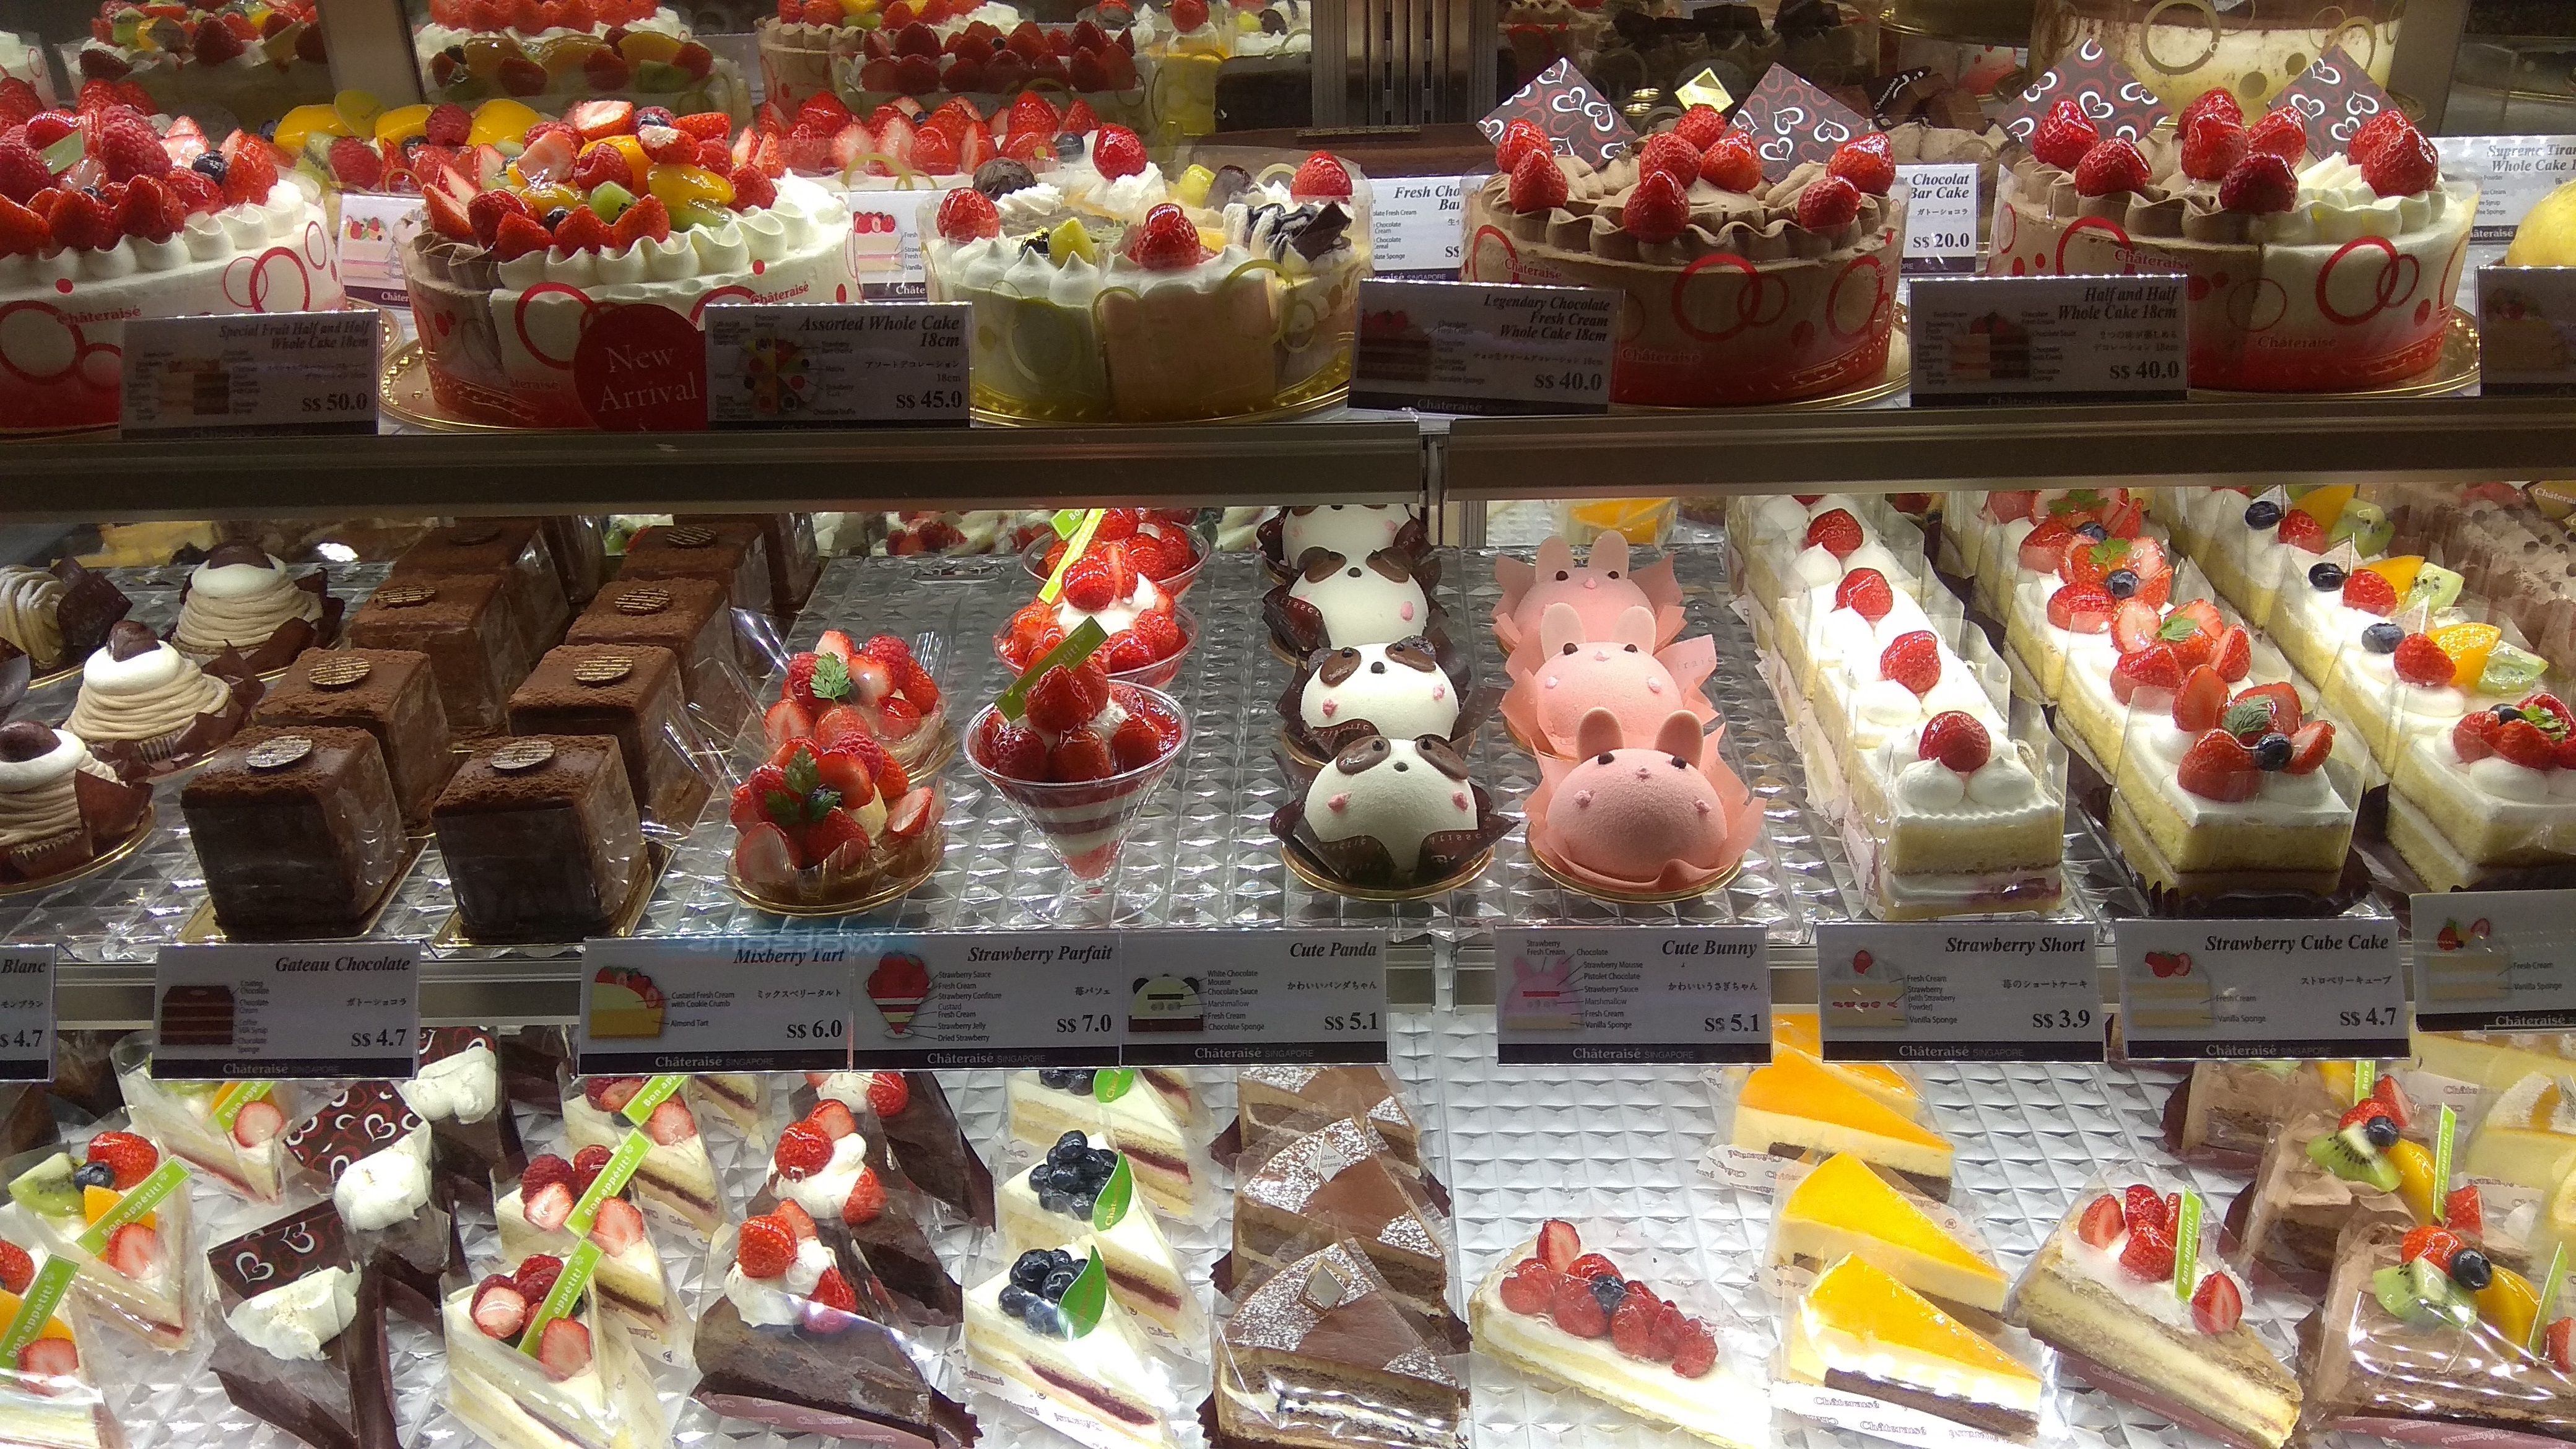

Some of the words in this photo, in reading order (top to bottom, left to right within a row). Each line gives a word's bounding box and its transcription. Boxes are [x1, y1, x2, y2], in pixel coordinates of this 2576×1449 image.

[2492, 160, 2531, 172] Whole
[2536, 159, 2567, 171] Cake
[1913, 173, 1969, 185] Chocolat
[1393, 186, 1430, 198] Fresh
[1936, 187, 1969, 198] Cake
[1913, 237, 1930, 248] S$
[1933, 233, 1969, 248] 20.0
[1484, 294, 1547, 310] Legendary
[1550, 297, 1610, 311] Chocolate
[2085, 288, 2115, 303] Half
[2117, 289, 2143, 302] and
[2146, 287, 2177, 302] Half
[1530, 310, 1565, 326] Fresh
[1568, 314, 1608, 327] Cream
[2058, 305, 2101, 321] Whole
[2104, 307, 2139, 320] Cake
[2143, 305, 2177, 320] 18cm
[219, 323, 257, 340] Special
[263, 322, 289, 337] Fruit
[320, 321, 340, 334] and
[343, 320, 370, 336] Half
[798, 315, 863, 332] Assorted
[869, 314, 916, 331] Whole
[921, 315, 959, 331] Cake
[920, 333, 960, 347] 18cm
[1500, 324, 1538, 338] Whole
[1541, 327, 1572, 340] Cake
[1575, 330, 1607, 342] 18cm
[272, 335, 306, 350] Whole
[309, 336, 336, 348] Cake
[604, 344, 675, 373] New
[2135, 361, 2179, 379] 40.0
[936, 374, 960, 383] 18cm
[1559, 372, 1603, 391] 40.0
[598, 372, 698, 412] Arrival
[921, 391, 962, 409] 45.0
[326, 393, 367, 411] 50.0
[1290, 942, 1325, 958] Cute
[1329, 942, 1377, 957] Panda
[1662, 940, 1700, 955] Cute
[1704, 940, 1758, 958] Bunny
[1946, 937, 2036, 955] Strawberry
[2039, 937, 2086, 952] Short
[2205, 934, 2296, 954] Strawberry
[2300, 934, 2343, 950] Cube
[2348, 934, 2389, 949] Cake
[733, 948, 806, 966] Mixberry
[812, 948, 844, 962] Tart
[968, 946, 1054, 965] Strawberry
[1056, 945, 1112, 961] Parfait
[1, 959, 46, 973] Blanc
[276, 957, 331, 972] Gateau
[335, 957, 411, 971] Chocolate
[1907, 985, 1943, 994] Strawberry
[2537, 983, 2562, 991] Sponge
[938, 992, 972, 1001] Strawberry
[1924, 994, 1956, 1003] Strawberry
[1056, 1018, 1076, 1033] S$
[1082, 1014, 1112, 1033] 7.0
[1325, 1016, 1344, 1030] S$
[1349, 1012, 1378, 1030] 5.1
[1705, 1017, 1725, 1032] S$
[1731, 1013, 1760, 1032] 5.1
[1932, 1016, 1957, 1025] Sponge
[2033, 1014, 2053, 1028] S$
[2059, 1009, 2091, 1029] 3.9
[2339, 1011, 2361, 1026] S$
[2365, 1007, 2397, 1025] 4.7
[2496, 1016, 2565, 1026] Châteraisé
[787, 1024, 806, 1038] S$
[812, 1020, 842, 1038] 6.0
[938, 1022, 971, 1030] Strawberry
[973, 1022, 986, 1030] Jelly
[14, 1030, 43, 1047] 4.7
[376, 1029, 407, 1046] 4.7
[956, 1034, 990, 1042] Strawberry
[928, 1051, 993, 1064] Châteraisé
[1195, 1047, 1261, 1059] Châteraisé
[1573, 1047, 1640, 1059] Châteraisé
[1645, 1051, 1694, 1059] SINGAPORE
[1899, 1045, 1969, 1058] Châteraisé
[1973, 1048, 2024, 1057] SINGAPORE
[2206, 1044, 2276, 1056] Châteraisé
[223, 1063, 288, 1074] Châteraisé
[655, 1055, 722, 1068] Châteraisé
[643, 1089, 662, 1107] Bon
[584, 1197, 602, 1216] Bon
[600, 1155, 632, 1196] appétit!
[102, 1219, 126, 1238] Bon
[123, 1183, 162, 1224] appétit!
